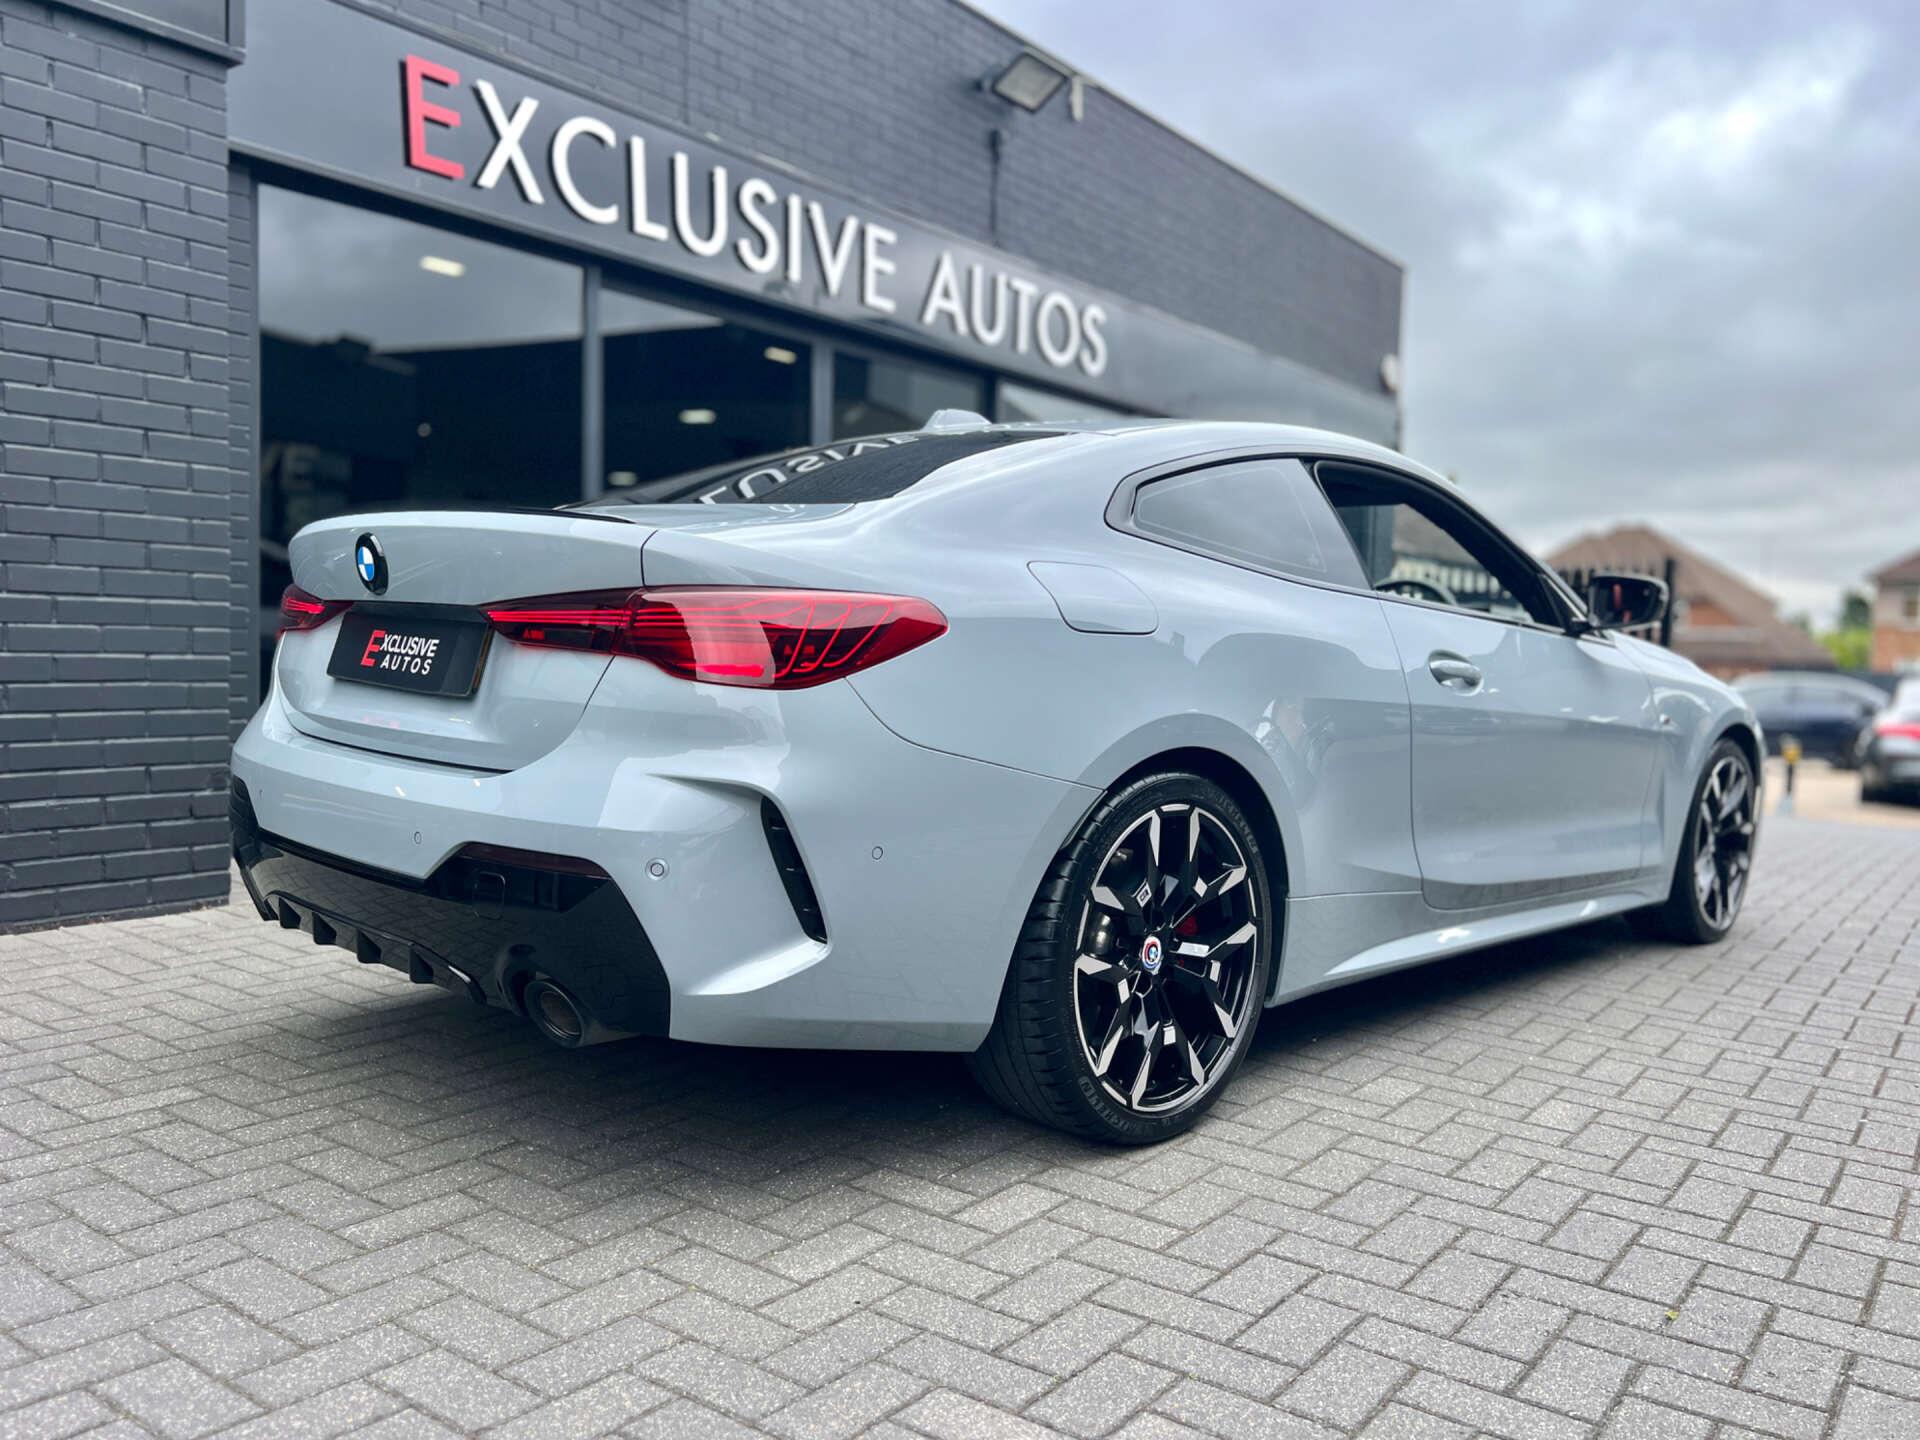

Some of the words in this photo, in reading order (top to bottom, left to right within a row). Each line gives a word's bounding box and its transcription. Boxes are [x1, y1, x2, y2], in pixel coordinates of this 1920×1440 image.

[404, 54, 898, 314] EXCLUSIVE
[922, 252, 1109, 377] AUTOS
[361, 629, 440, 667] EXCLUSIVE
[380, 653, 433, 675] AUTOS
